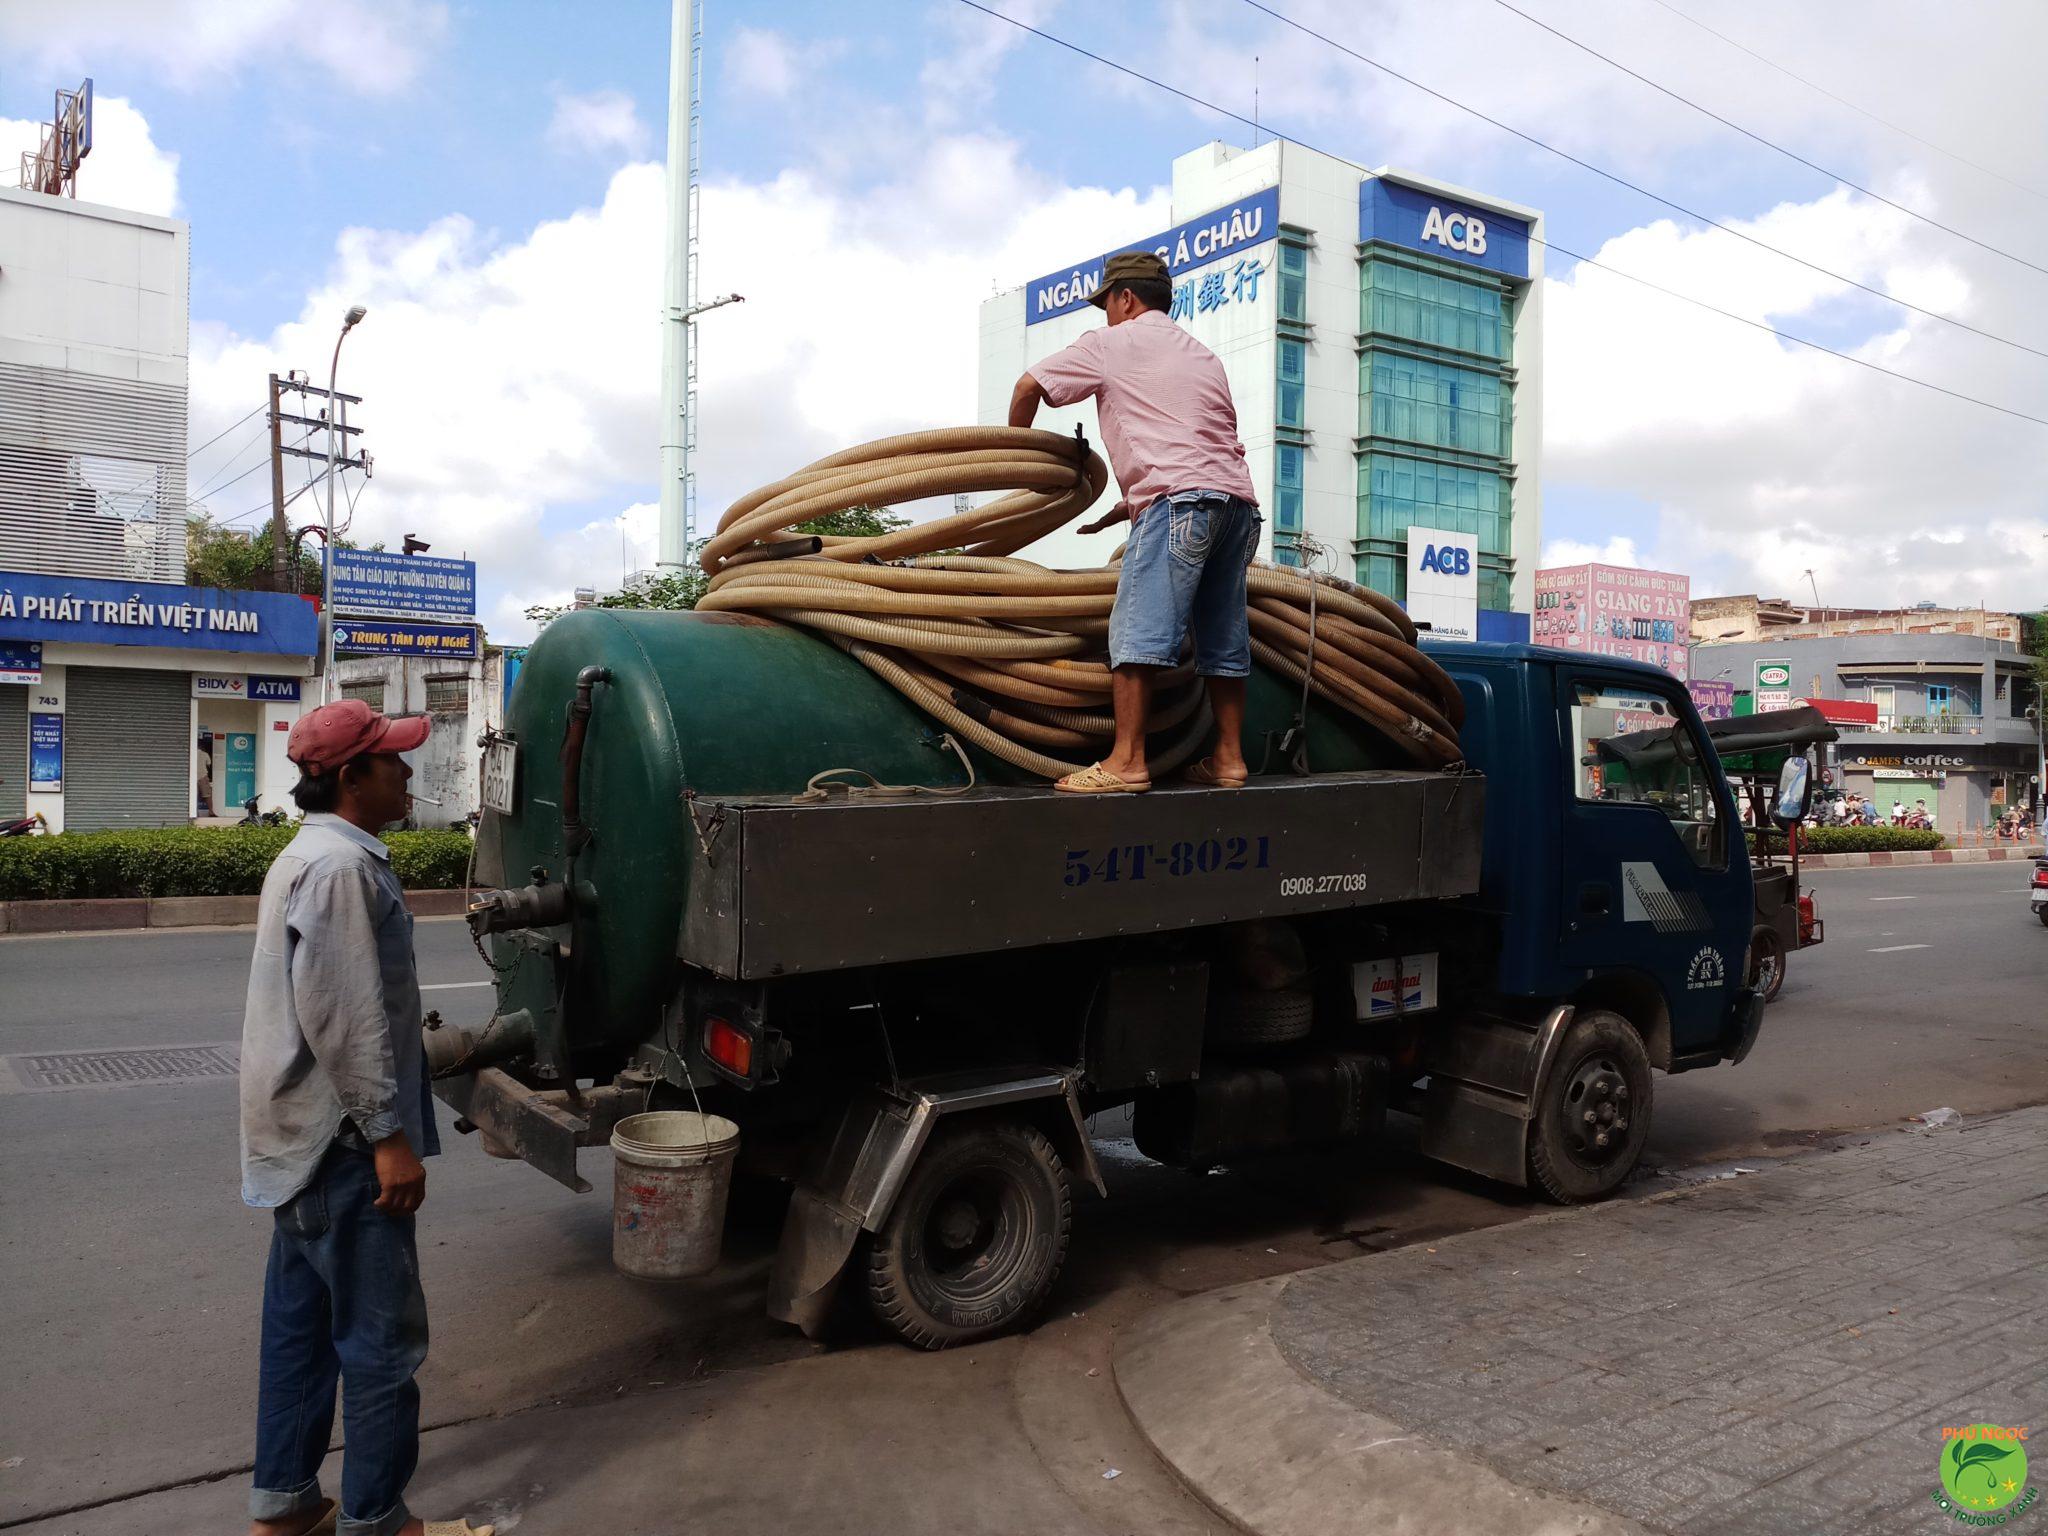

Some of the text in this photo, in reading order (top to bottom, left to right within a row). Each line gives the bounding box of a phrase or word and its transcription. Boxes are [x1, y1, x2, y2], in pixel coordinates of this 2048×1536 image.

[1422, 206, 1487, 255] ACB
[1038, 269, 1099, 314] NGÂN
[1173, 230, 1190, 268] Á
[1193, 207, 1263, 258] CHÂU
[1170, 257, 1265, 322] 洲銀行
[1420, 543, 1470, 576] ACB
[333, 565, 351, 582] RUNG
[352, 563, 366, 582] TÂM
[367, 565, 382, 584] GIÁO
[383, 570, 398, 588] DỤC
[426, 571, 448, 590] XUYÊN
[448, 573, 465, 593] QUẬN
[465, 577, 471, 591] 6
[1557, 573, 1575, 587] GIANG
[0, 588, 259, 634] À PHÁT TRIỂN VIỆT NAM
[333, 595, 350, 604] UYỆN
[1595, 589, 1688, 618] GIANG TÂY
[351, 631, 388, 645] TRUNG
[416, 634, 439, 651] DẠY
[198, 678, 230, 689] BIDV
[256, 681, 293, 696] ATM
[38, 696, 59, 706] 743
[1866, 754, 1964, 766] JAMES coffee
[487, 774, 508, 810] 8021
[1063, 835, 1270, 888] 54T-8021
[1280, 873, 1367, 897] 0908.277038
